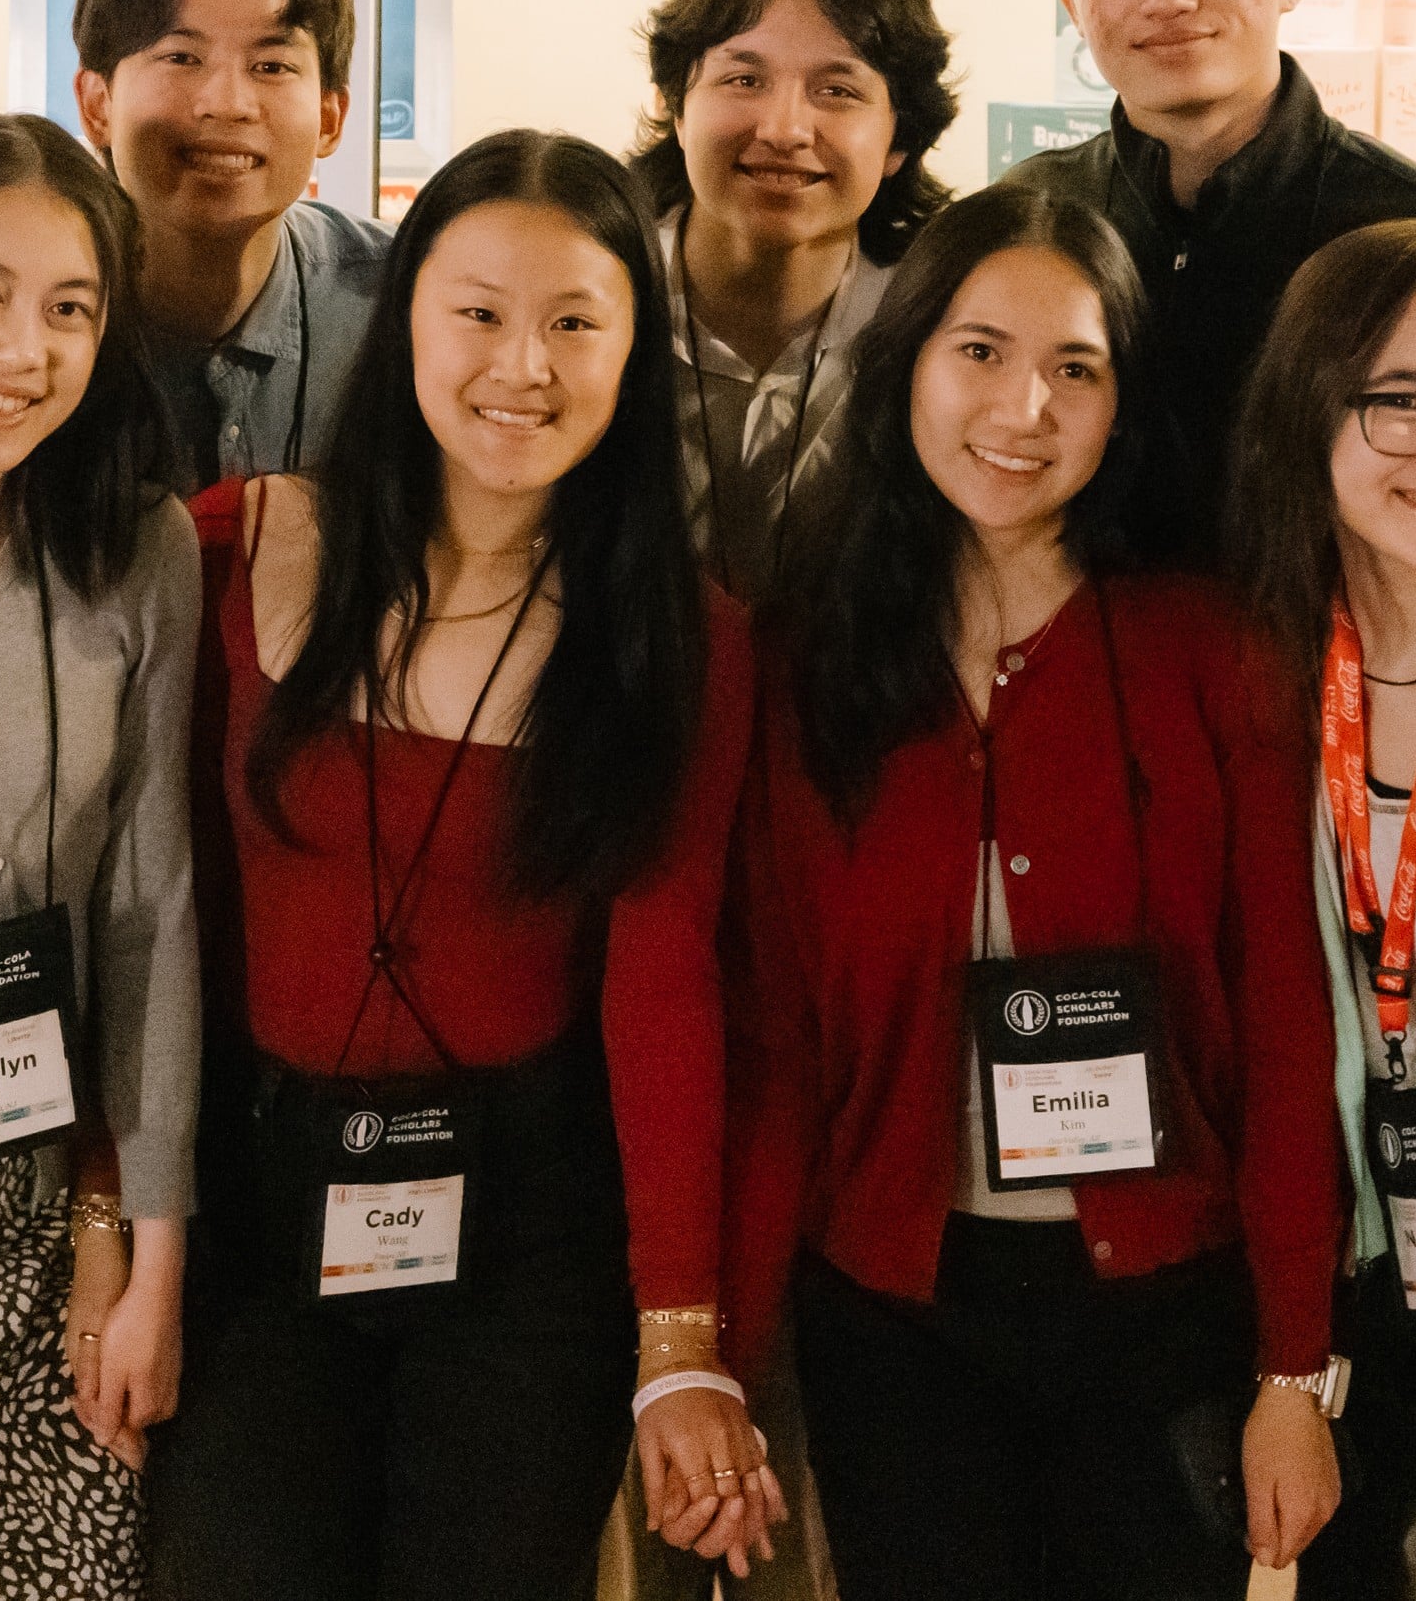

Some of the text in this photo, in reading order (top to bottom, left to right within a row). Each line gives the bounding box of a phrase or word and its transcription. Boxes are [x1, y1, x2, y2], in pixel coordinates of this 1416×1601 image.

[1054, 989, 1122, 1003] COCA-COLA
[1056, 1001, 1116, 1015] SCHOLARS
[1057, 1012, 1130, 1027] FOUNDATION
[1032, 1089, 1111, 1114] Emilia
[390, 1107, 449, 1123] COCA-COLA
[388, 1119, 442, 1133] SCHOLARS
[385, 1130, 454, 1144] FOUNDATION
[365, 1206, 425, 1229] Cady
